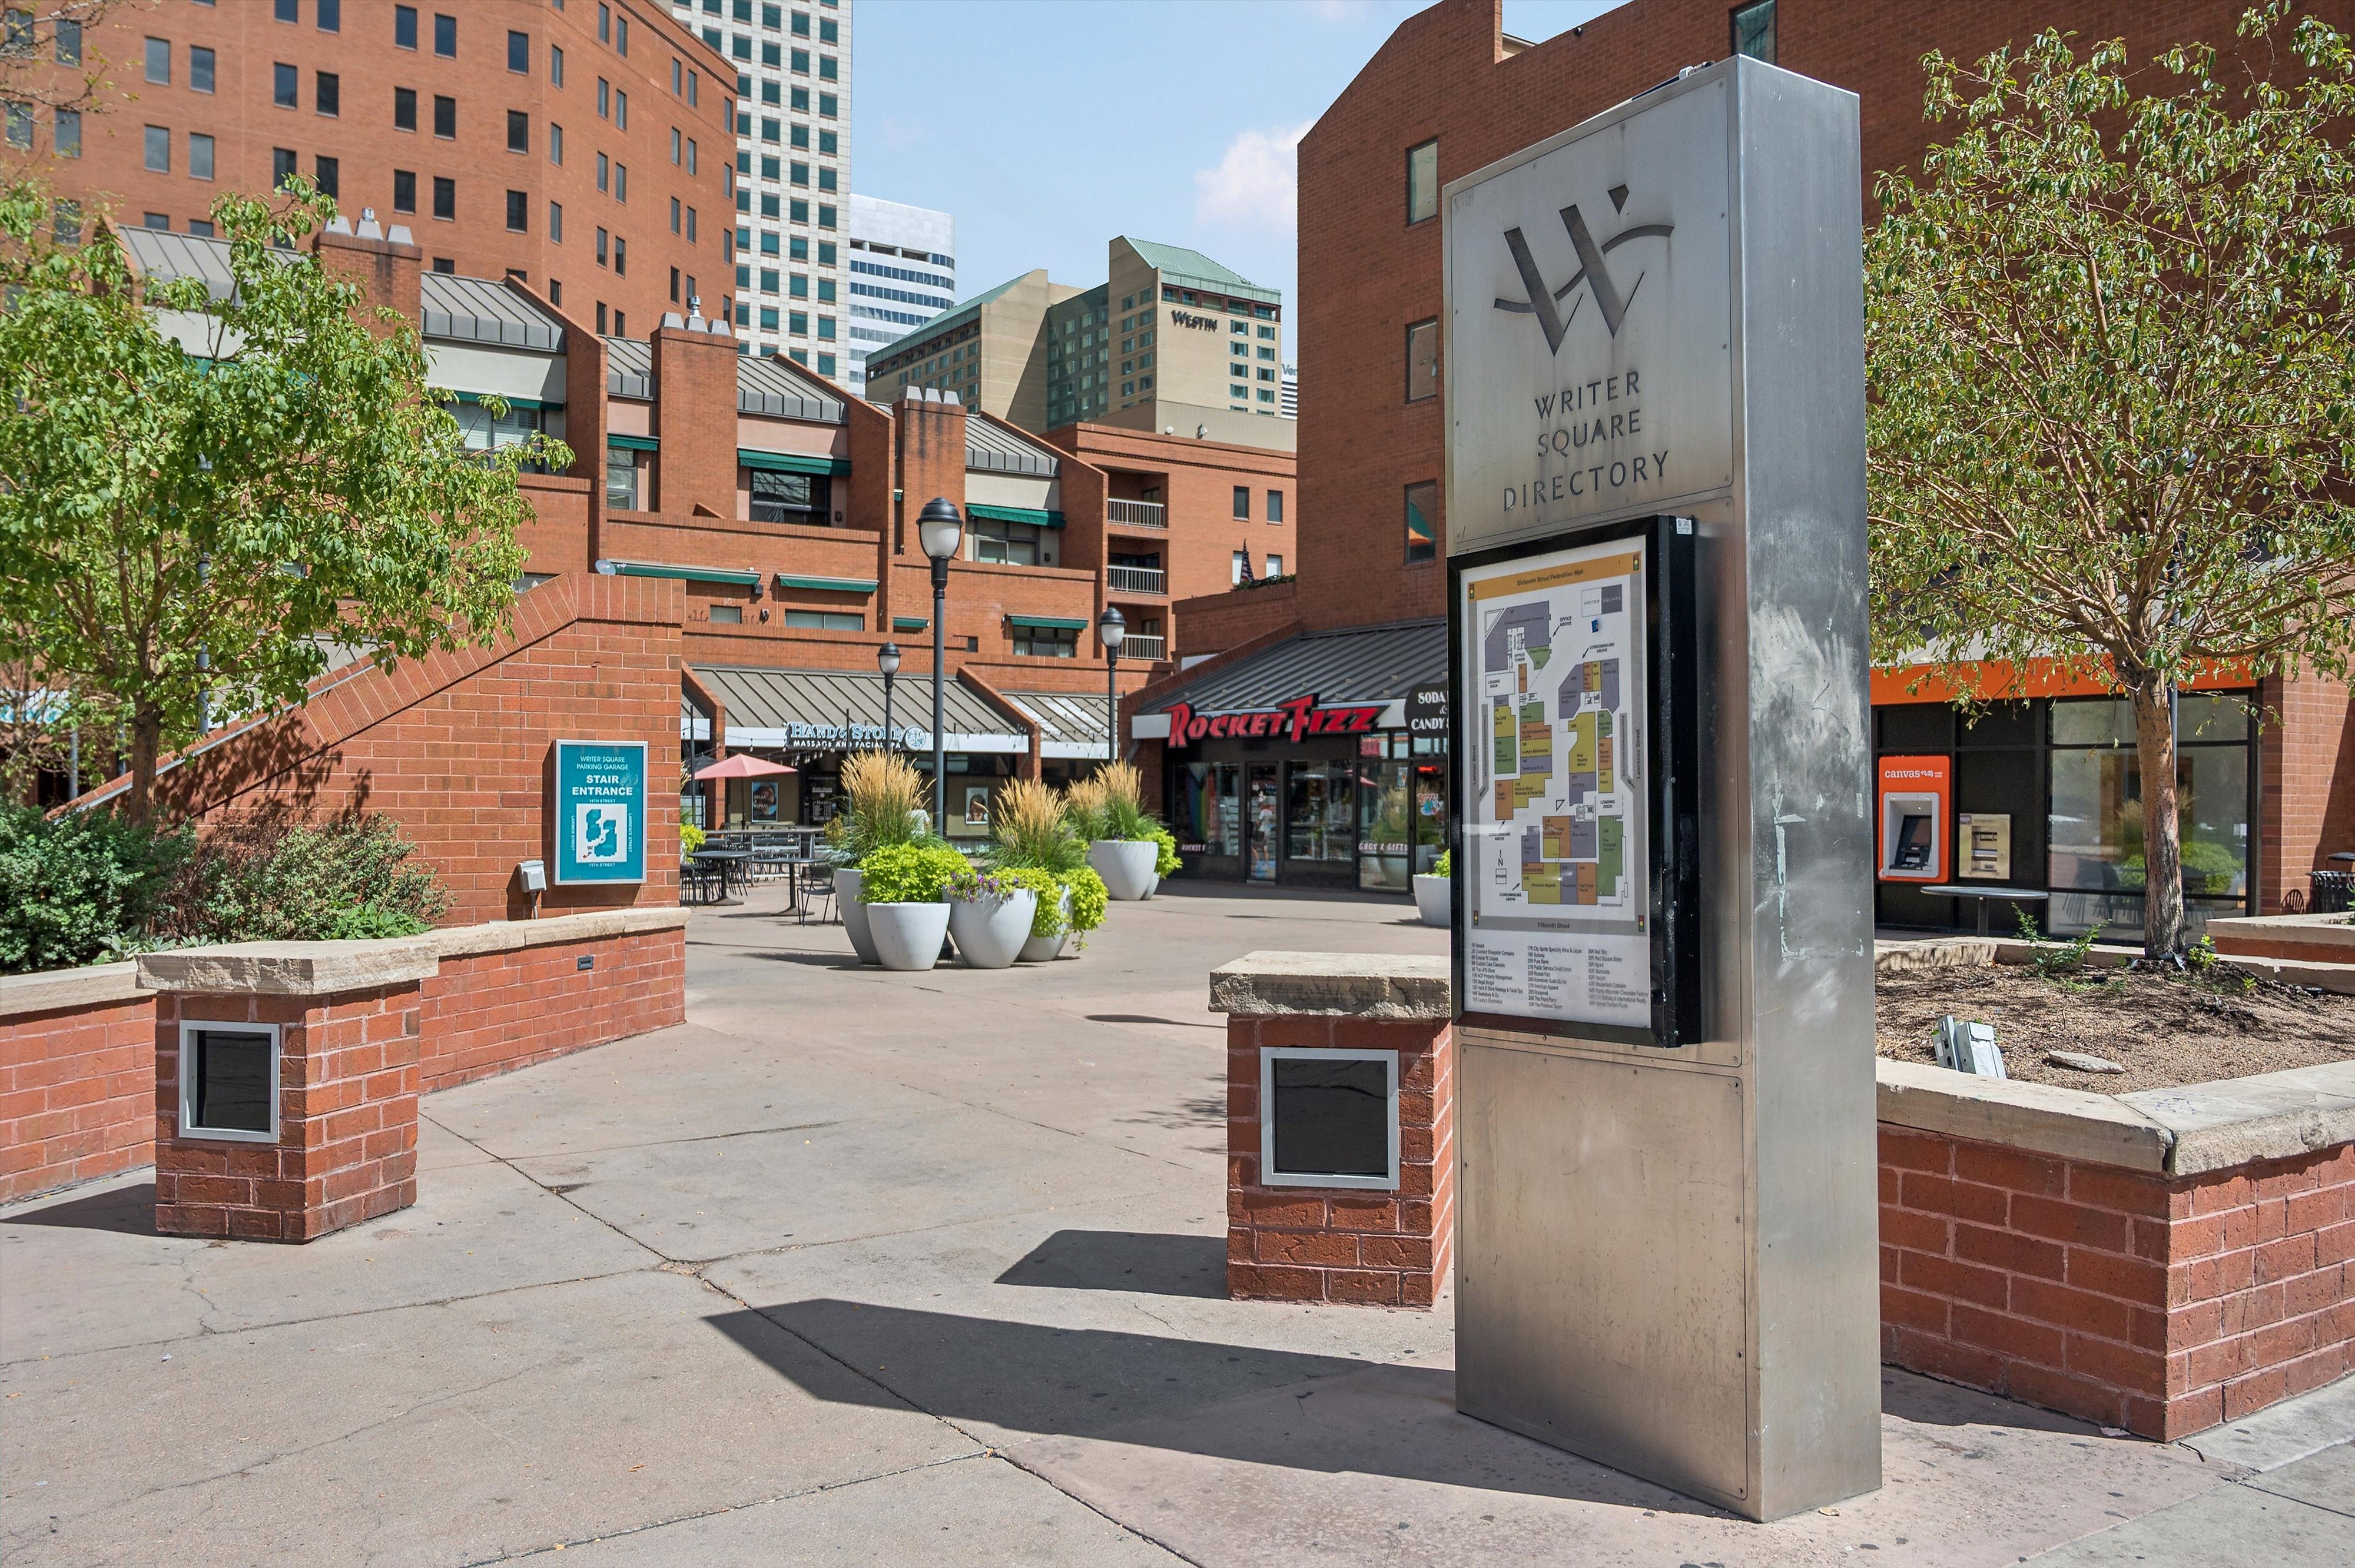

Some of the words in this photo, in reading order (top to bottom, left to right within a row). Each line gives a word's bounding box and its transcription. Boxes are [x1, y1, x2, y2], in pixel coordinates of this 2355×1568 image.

[1171, 310, 1218, 332] WESTIN
[1535, 371, 1640, 420] WRITER
[1537, 410, 1641, 457] SQUARE
[1503, 451, 1669, 512] DIRECTORY
[1550, 572, 1573, 580] Pedestrian
[1418, 691, 1446, 704] SODA
[1439, 705, 1448, 715] &
[1161, 703, 1288, 748] ROCKET
[1276, 694, 1381, 743] FIZZ
[1411, 718, 1445, 730] CANDY
[791, 723, 837, 739] HAND
[794, 740, 832, 748] MASSAGE
[586, 775, 619, 784] STAIR
[1885, 770, 1920, 778] canvas
[572, 787, 633, 796] ENTRANCE
[1358, 842, 1378, 851] GAGS
[1387, 843, 1408, 851] GIFTS
